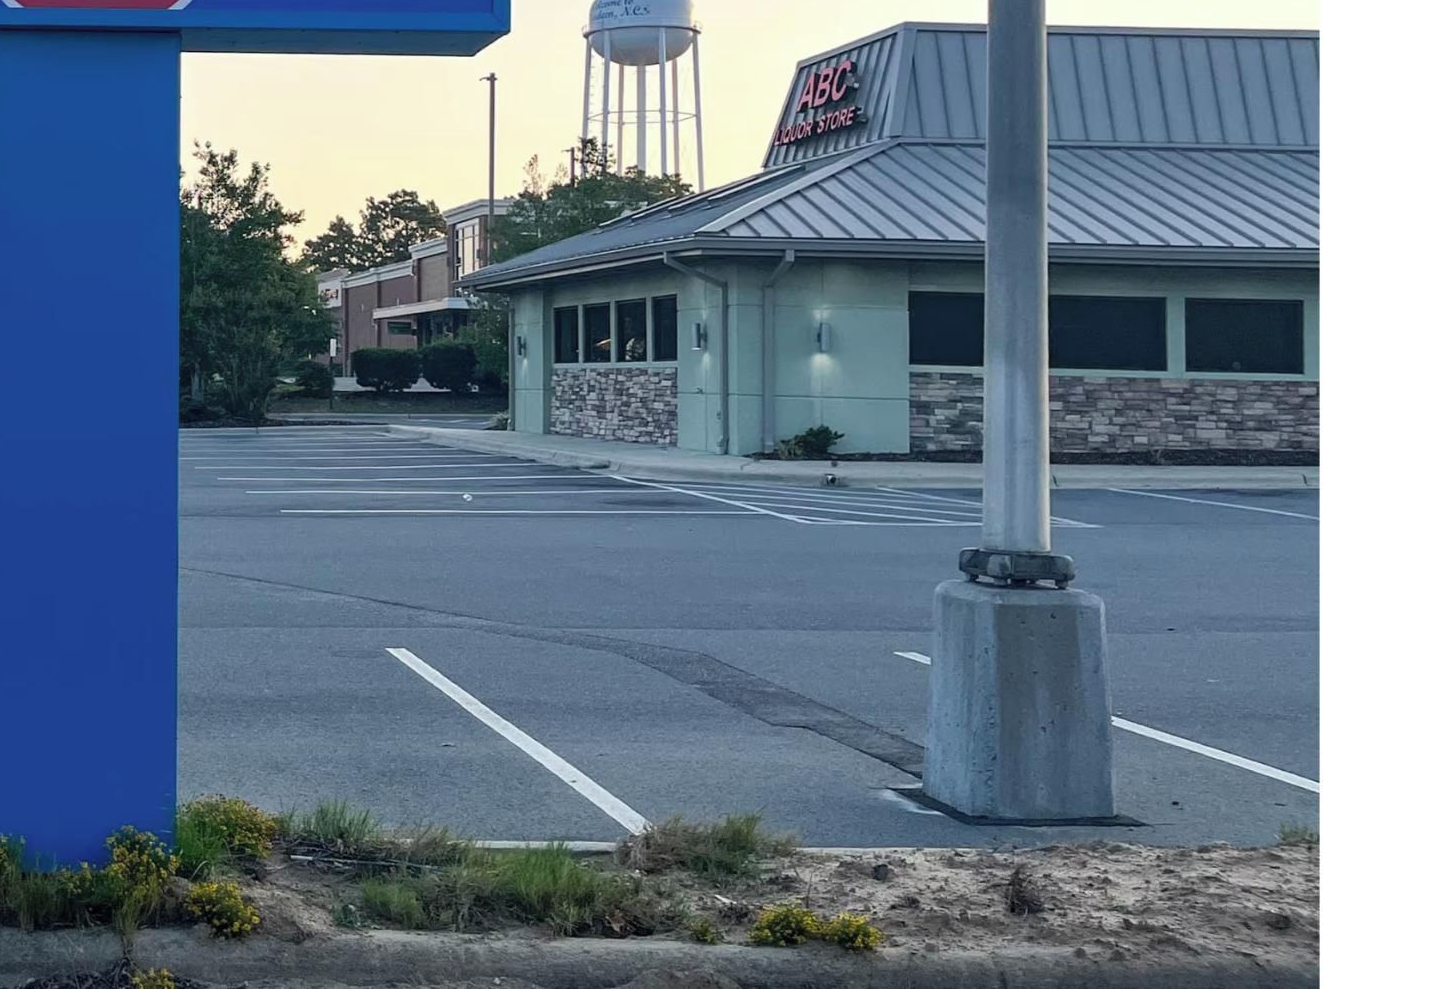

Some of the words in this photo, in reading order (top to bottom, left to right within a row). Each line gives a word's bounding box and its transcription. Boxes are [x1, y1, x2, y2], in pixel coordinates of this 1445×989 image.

[796, 59, 853, 113] ABC
[774, 119, 814, 147] LIQUOR
[817, 106, 856, 134] STORE
